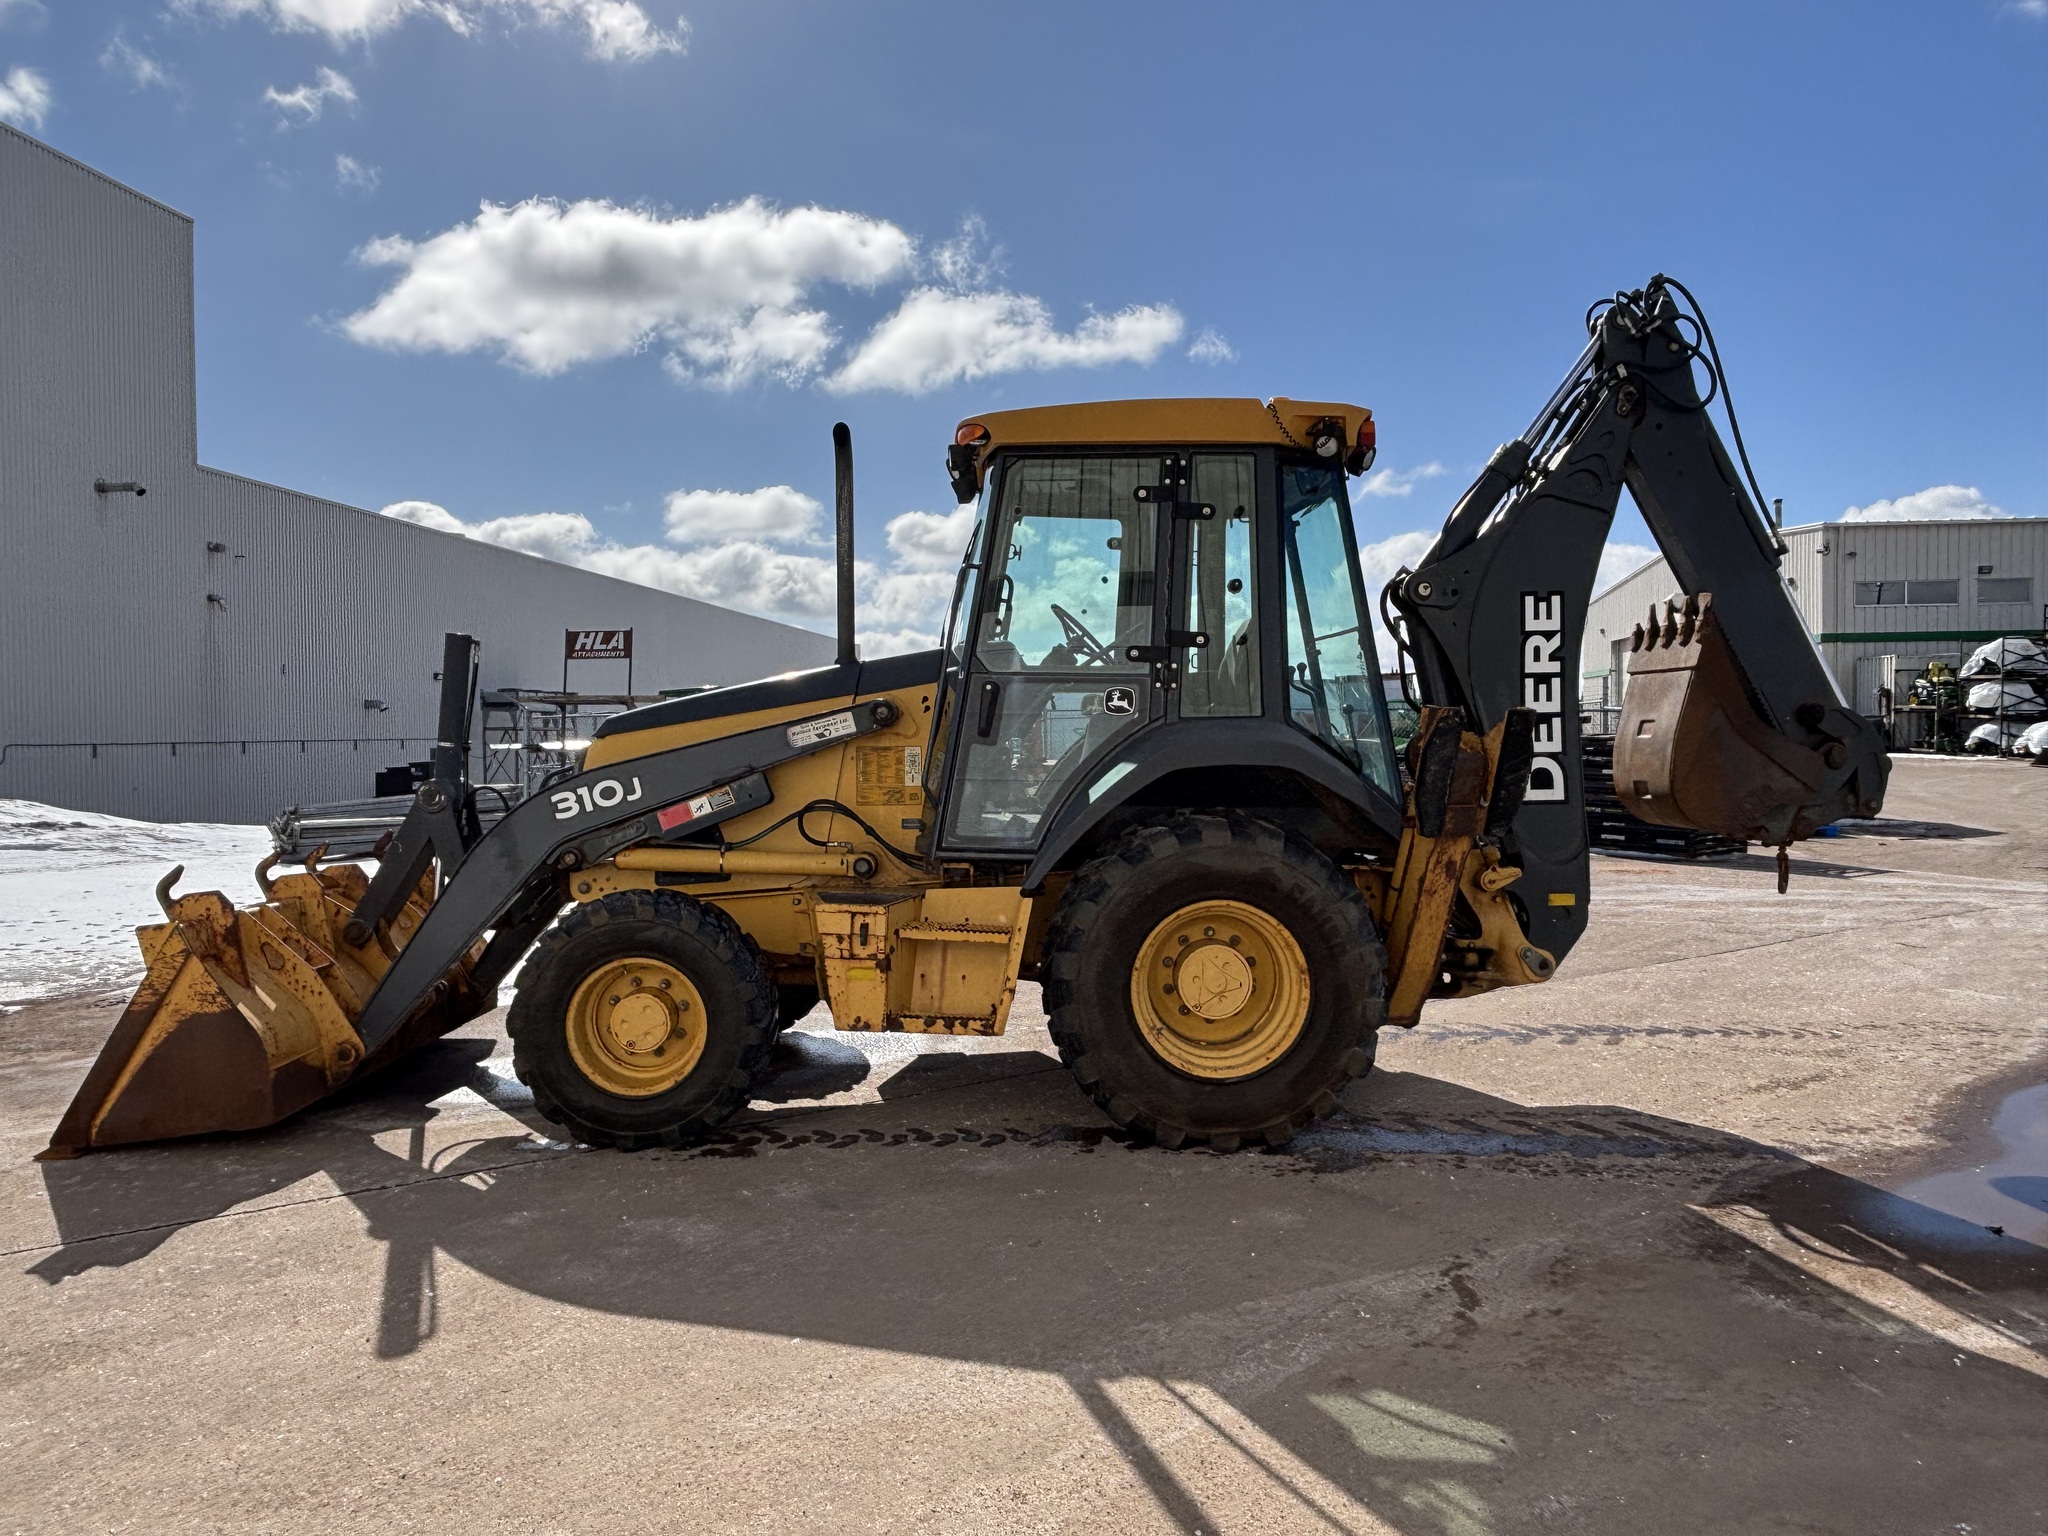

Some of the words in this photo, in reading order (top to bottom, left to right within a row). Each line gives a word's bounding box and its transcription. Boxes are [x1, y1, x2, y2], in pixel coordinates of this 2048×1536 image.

[574, 632, 624, 650] HLA
[1523, 595, 1565, 800] DEERE
[550, 777, 643, 820] 310J
